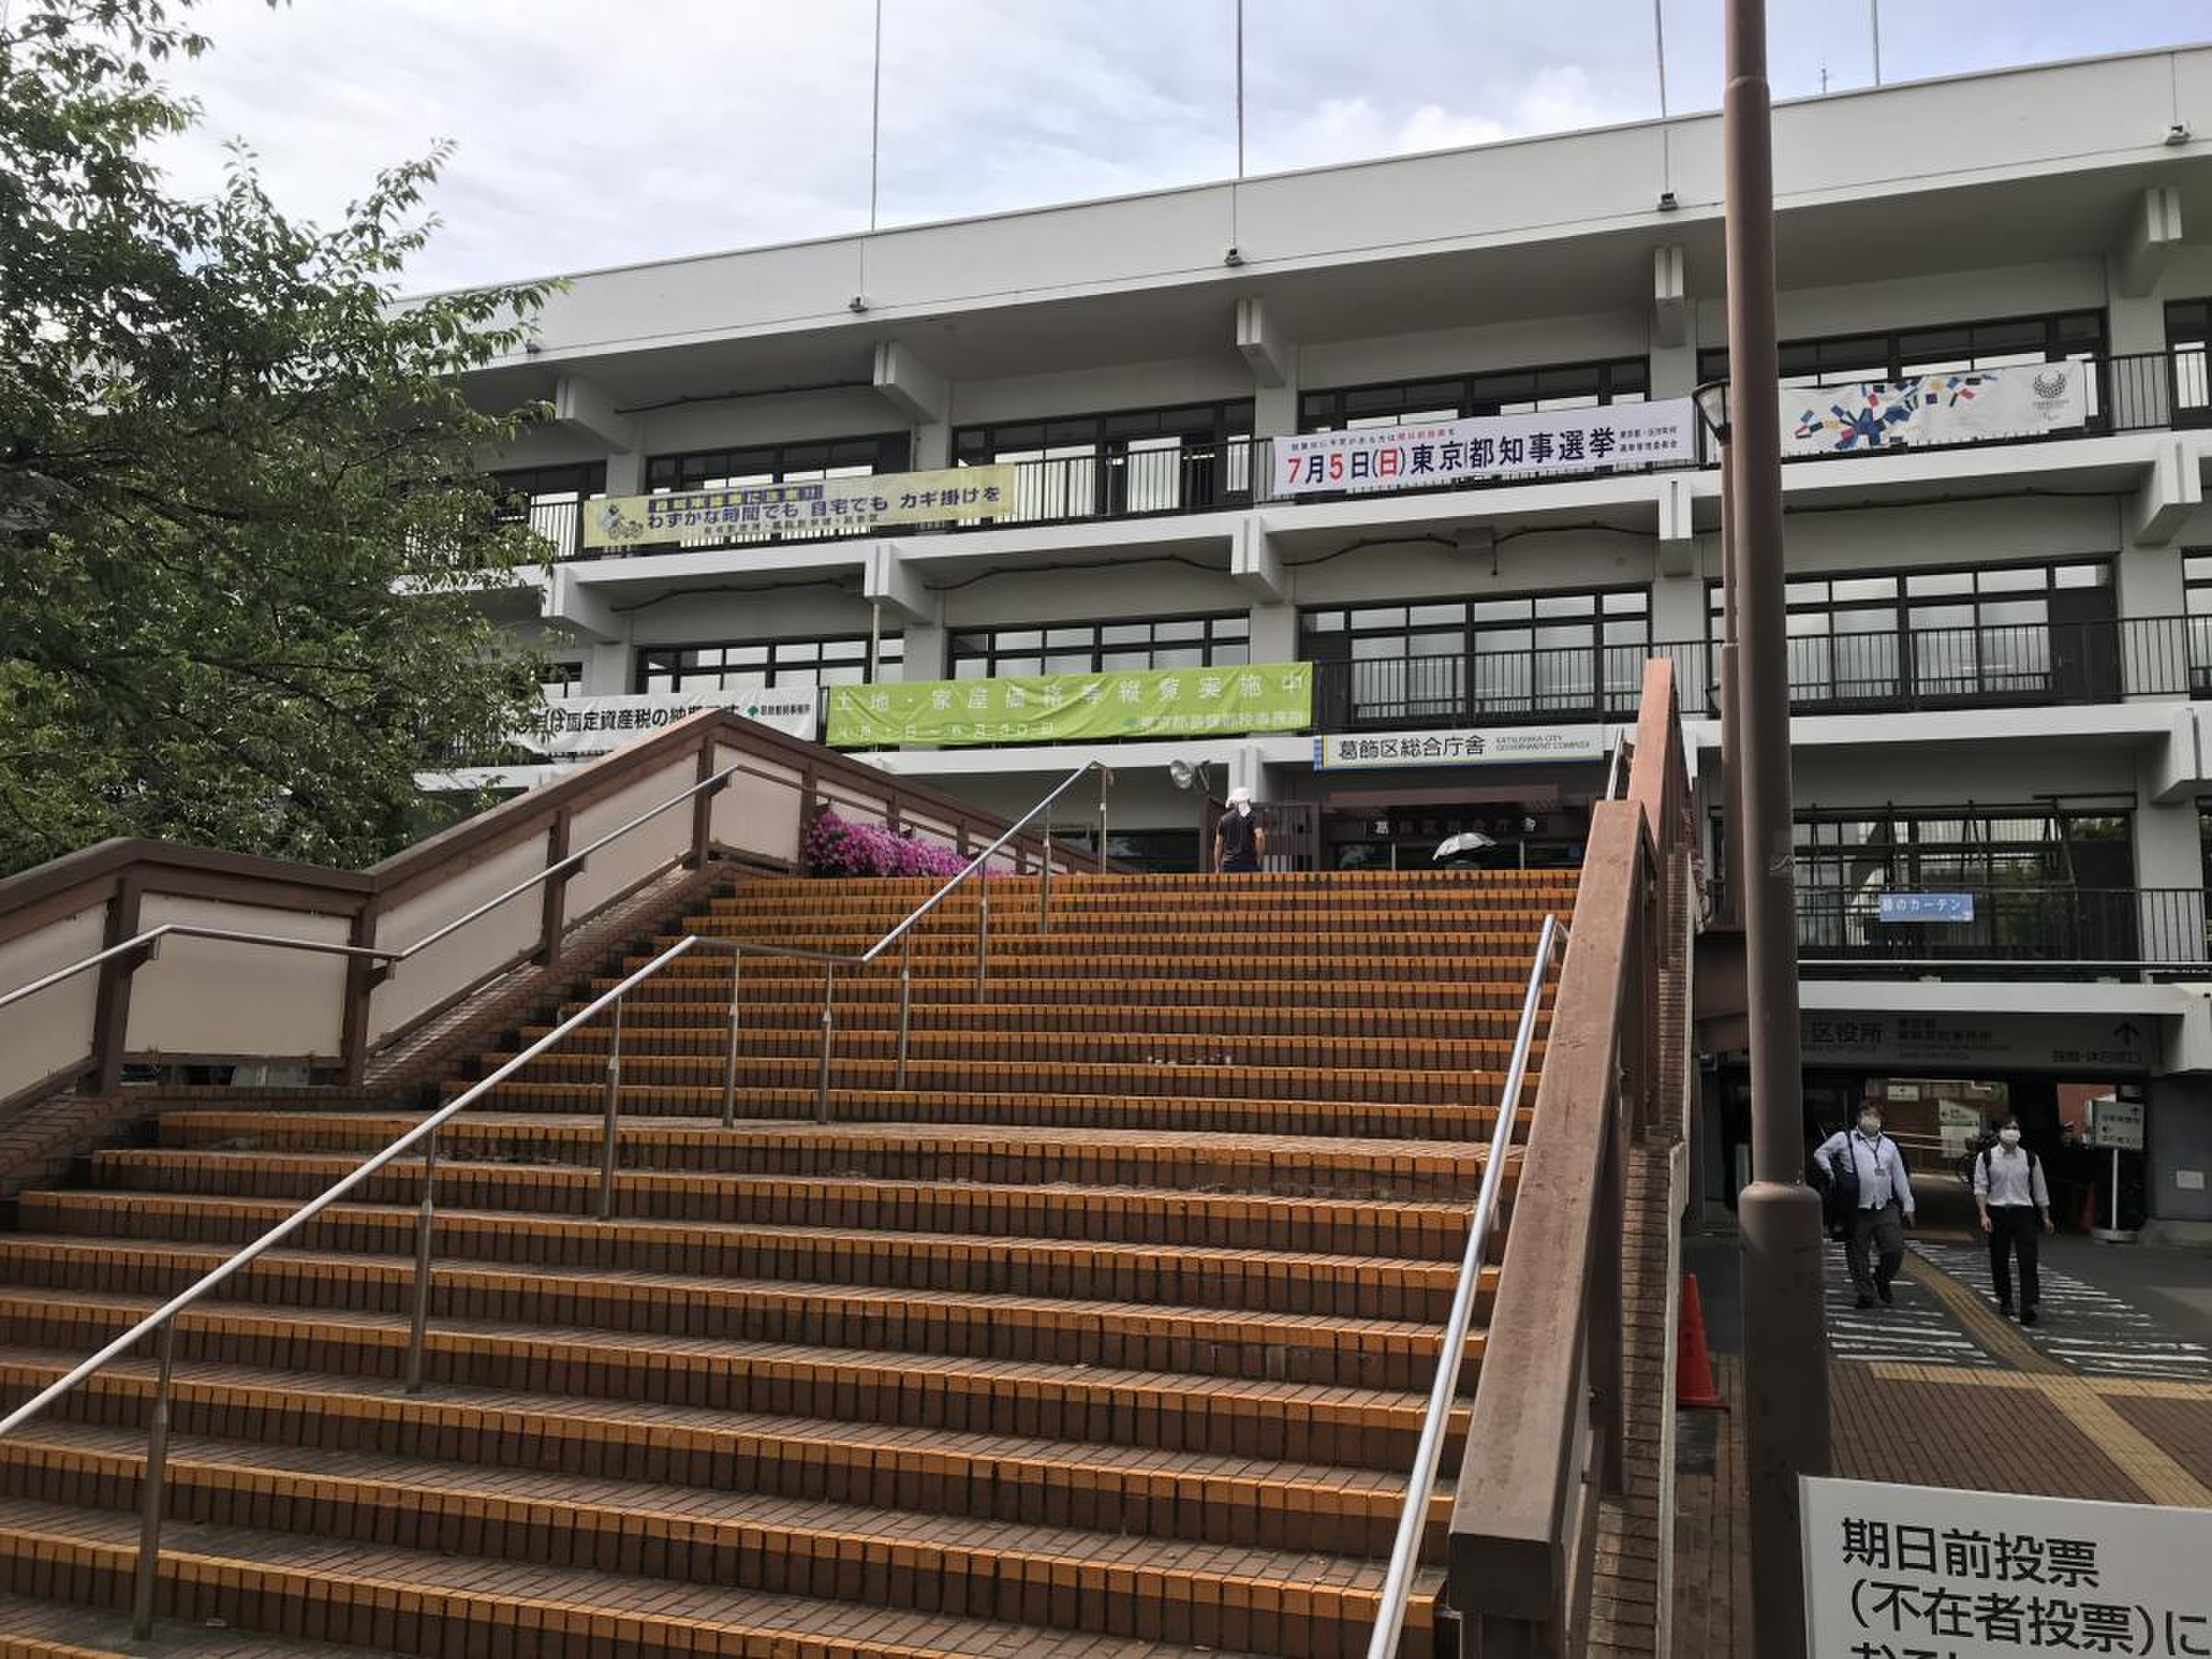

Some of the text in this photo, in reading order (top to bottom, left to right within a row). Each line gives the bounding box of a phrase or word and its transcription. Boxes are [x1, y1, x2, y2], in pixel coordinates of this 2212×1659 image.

[900, 485, 1001, 511] カギ掛けを
[1338, 735, 1486, 760] 葛飾区総合庁舎
[1842, 1517, 2100, 1588] 期日前投票
[1850, 1577, 2210, 1657] (不在者投票)に
